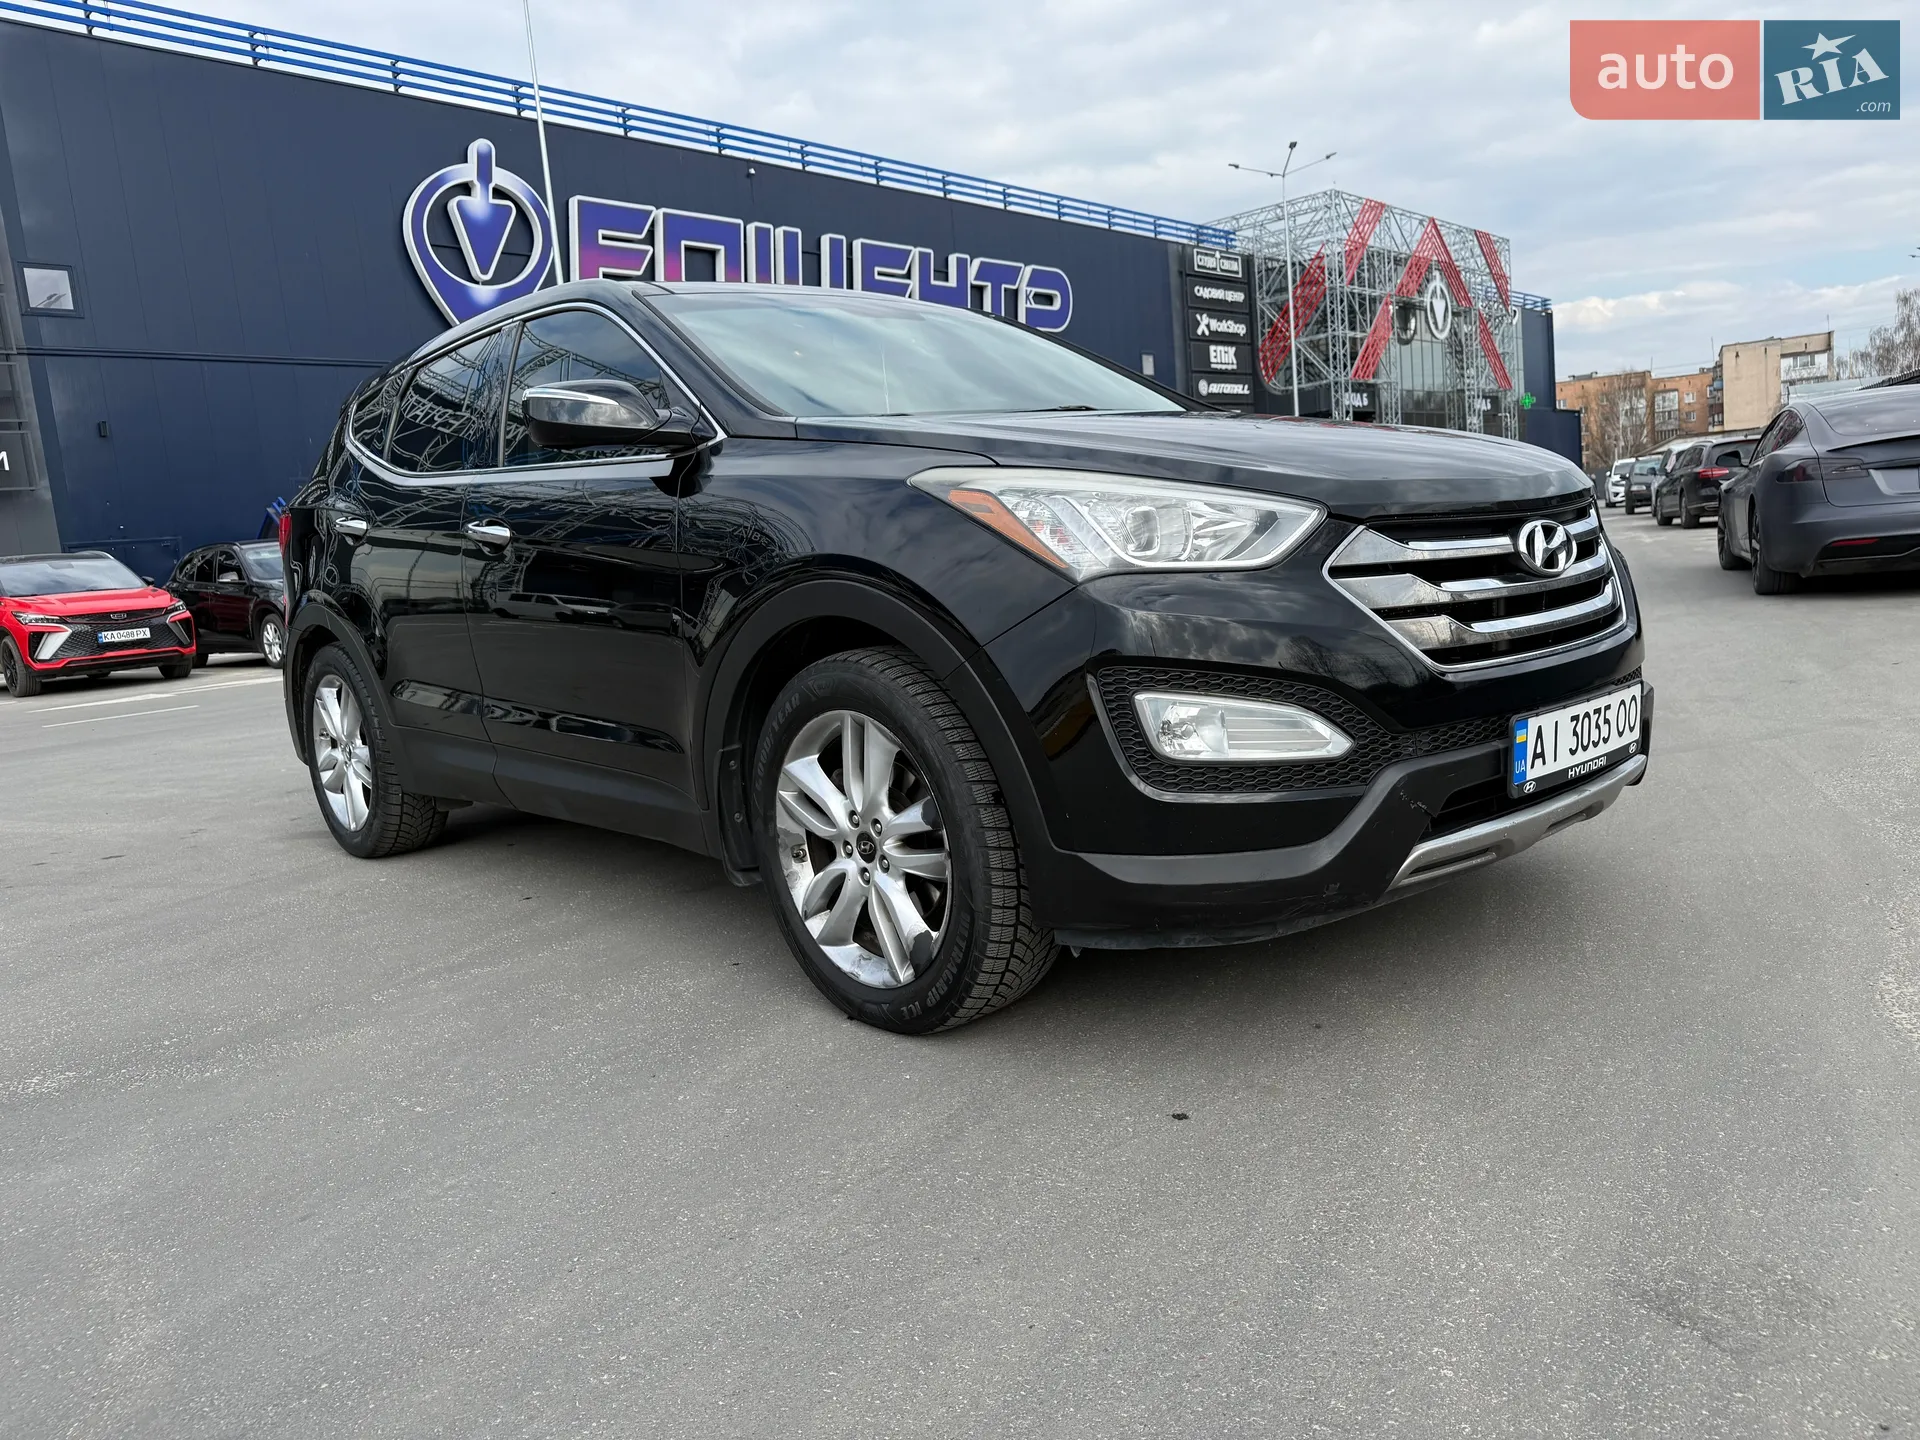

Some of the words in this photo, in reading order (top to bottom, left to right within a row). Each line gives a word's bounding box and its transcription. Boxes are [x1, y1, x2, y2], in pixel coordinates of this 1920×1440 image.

[1209, 318, 1247, 336] WorkShop
[1530, 720, 1559, 770] AI
[1568, 703, 1612, 756] 3035
[1616, 694, 1638, 738] OO
[1515, 758, 1526, 774] UA
[1568, 756, 1607, 779] HYUNDAI
